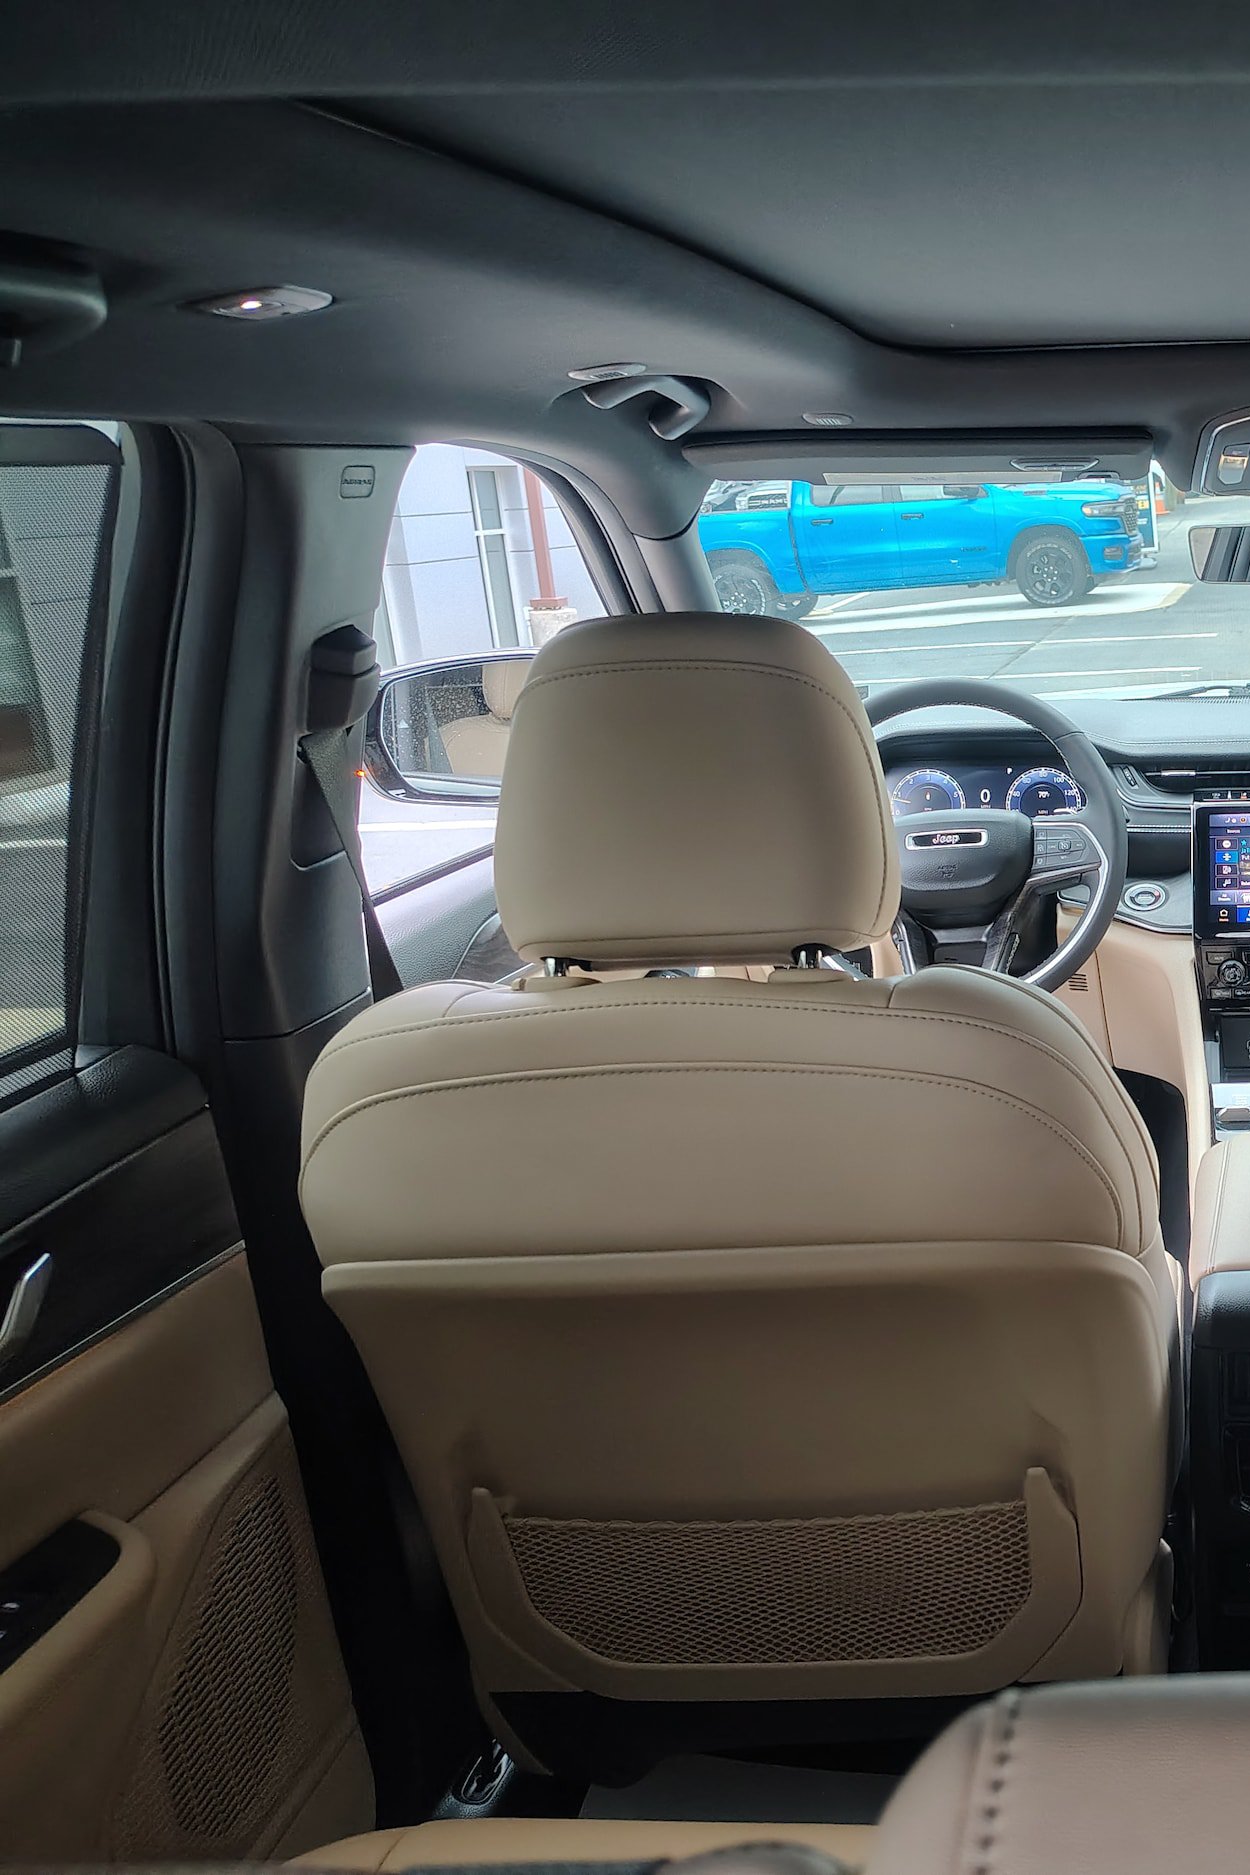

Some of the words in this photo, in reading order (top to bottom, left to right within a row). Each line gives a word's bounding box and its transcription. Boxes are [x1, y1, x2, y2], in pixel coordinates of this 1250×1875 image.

[1007, 767, 1013, 775] P
[980, 789, 991, 803] 0
[932, 834, 960, 845] Jeep
